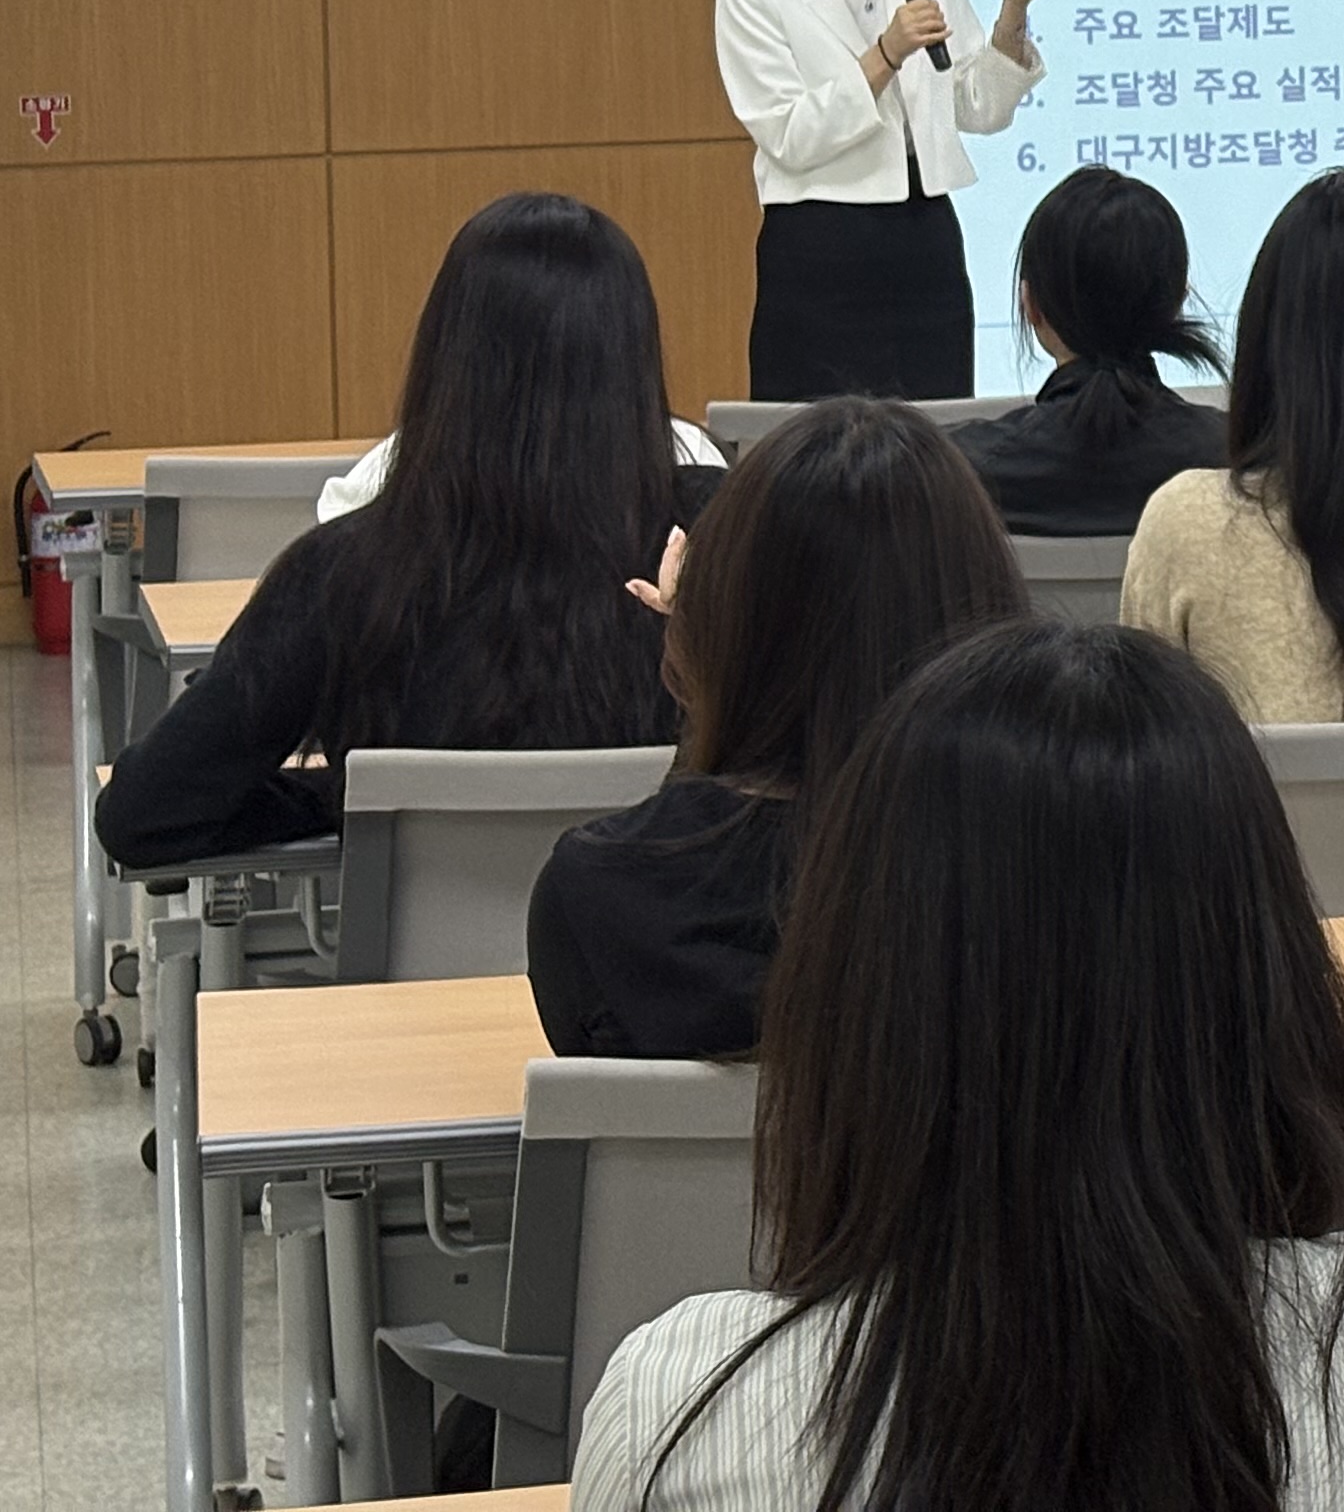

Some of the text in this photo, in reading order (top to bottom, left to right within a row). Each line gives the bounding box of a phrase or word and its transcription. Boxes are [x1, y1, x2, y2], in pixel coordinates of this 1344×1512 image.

[1073, 7, 1143, 46] 주요
[1156, 3, 1296, 42] 조달제도
[1075, 69, 1178, 108] 조달청
[1193, 68, 1262, 105] 주요
[1275, 64, 1341, 103] 실적
[1017, 142, 1046, 172] 6.
[1076, 127, 1318, 172] 대구지방조달청
